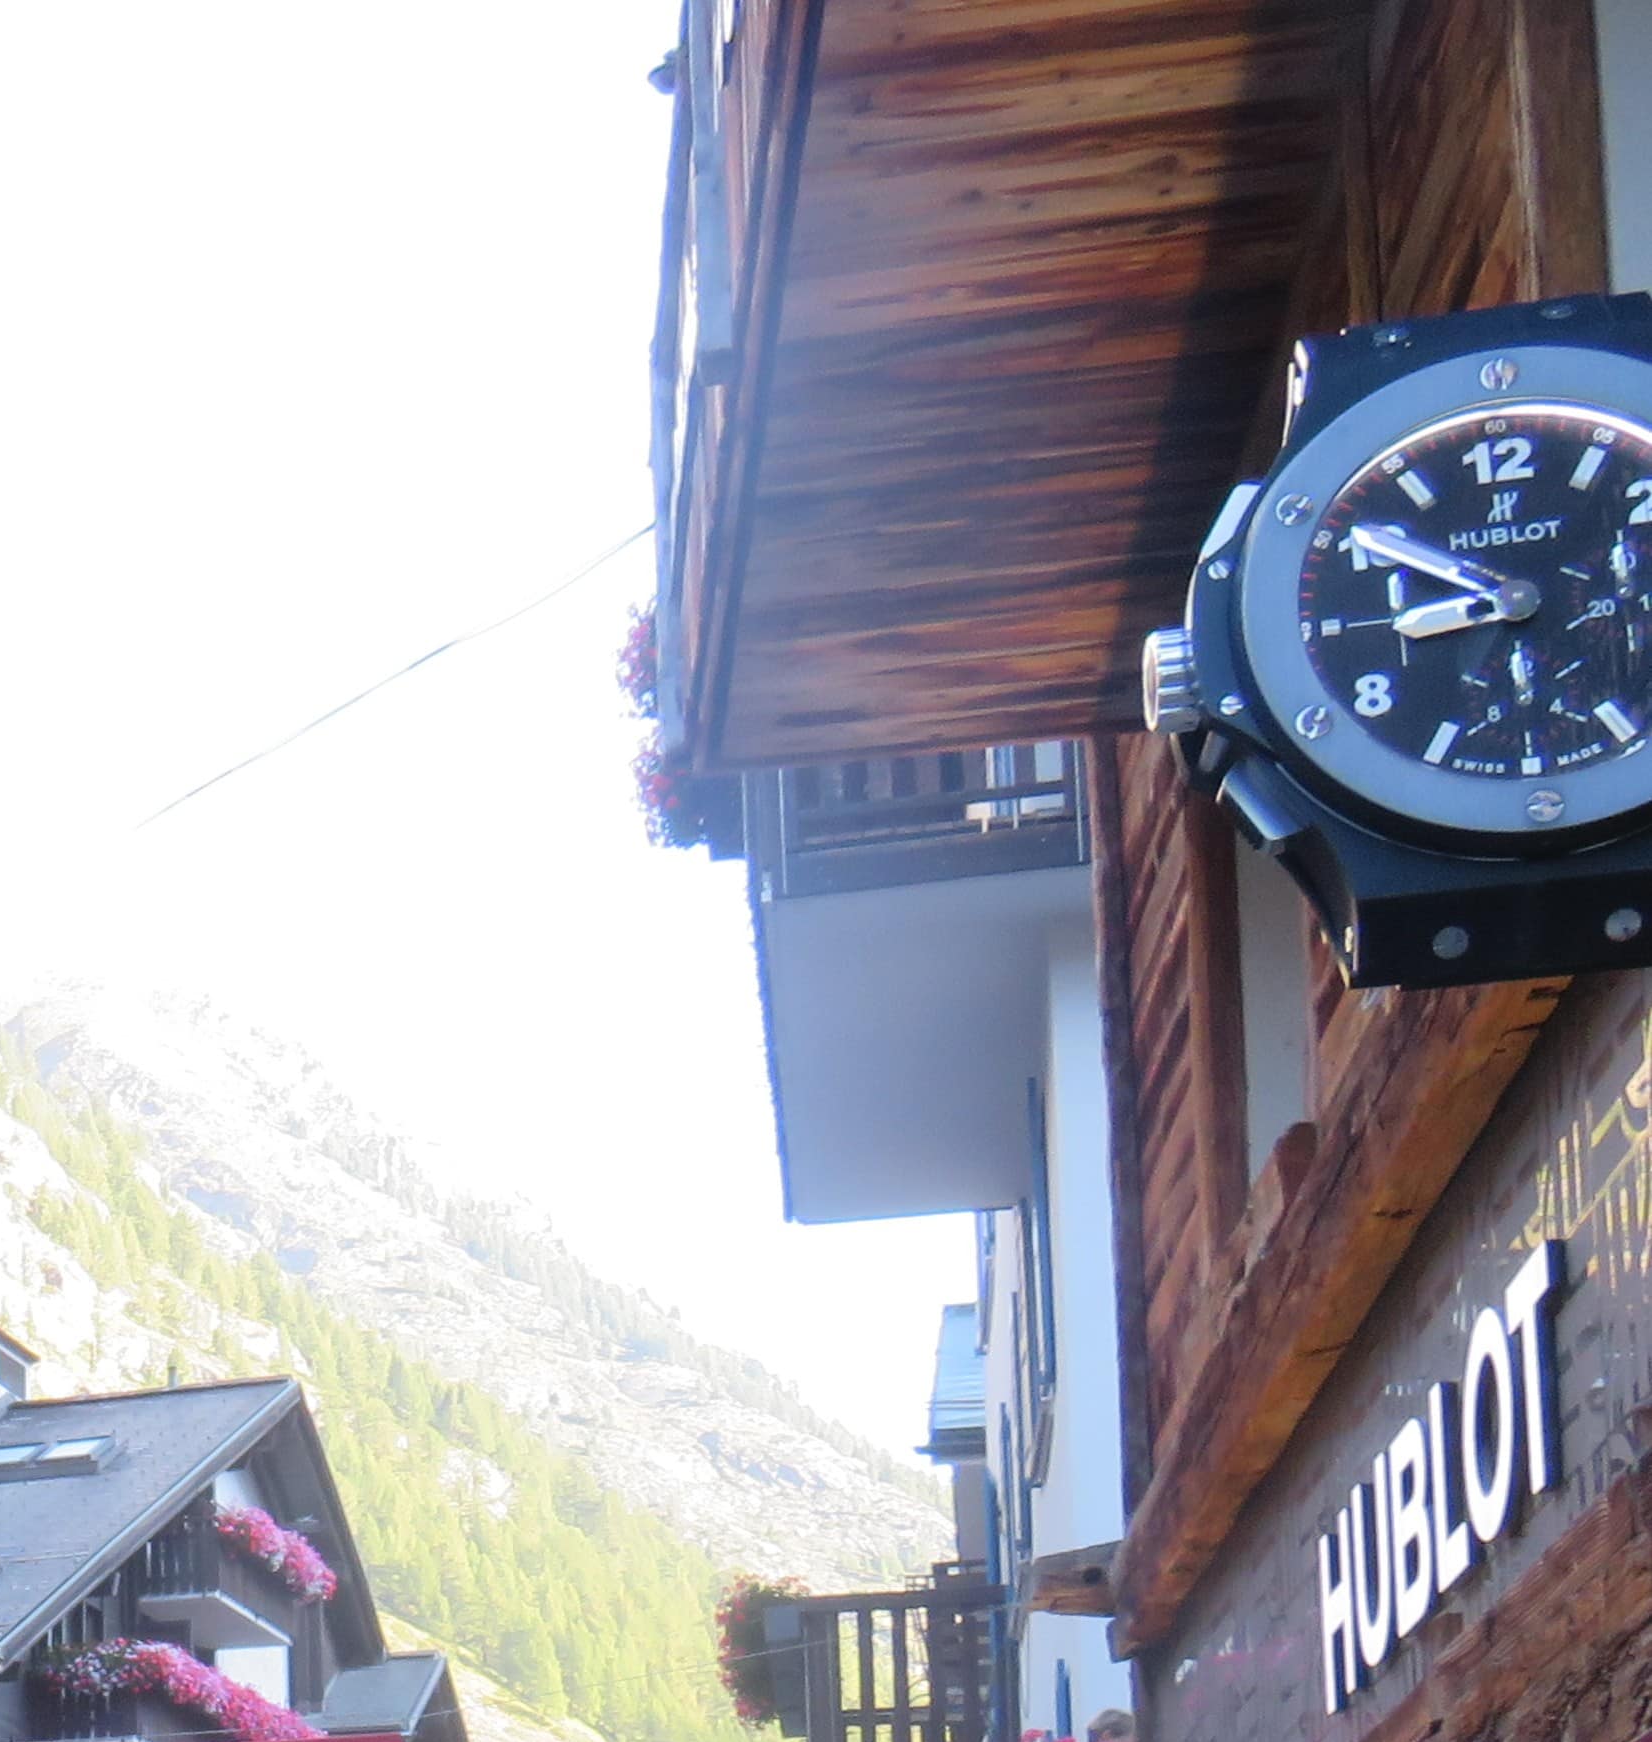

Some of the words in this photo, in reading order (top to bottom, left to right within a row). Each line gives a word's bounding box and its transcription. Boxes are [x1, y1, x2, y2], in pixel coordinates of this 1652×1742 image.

[1484, 418, 1507, 434] 60
[1592, 427, 1616, 445] 05
[1461, 436, 1536, 486] 12
[1449, 519, 1562, 551] HUBLOT
[1586, 598, 1617, 619] 20
[1353, 673, 1394, 718] 8
[1451, 757, 1506, 775] SWISS
[1555, 742, 1604, 768] MADE
[1317, 1239, 1560, 1717] HUBLOT
